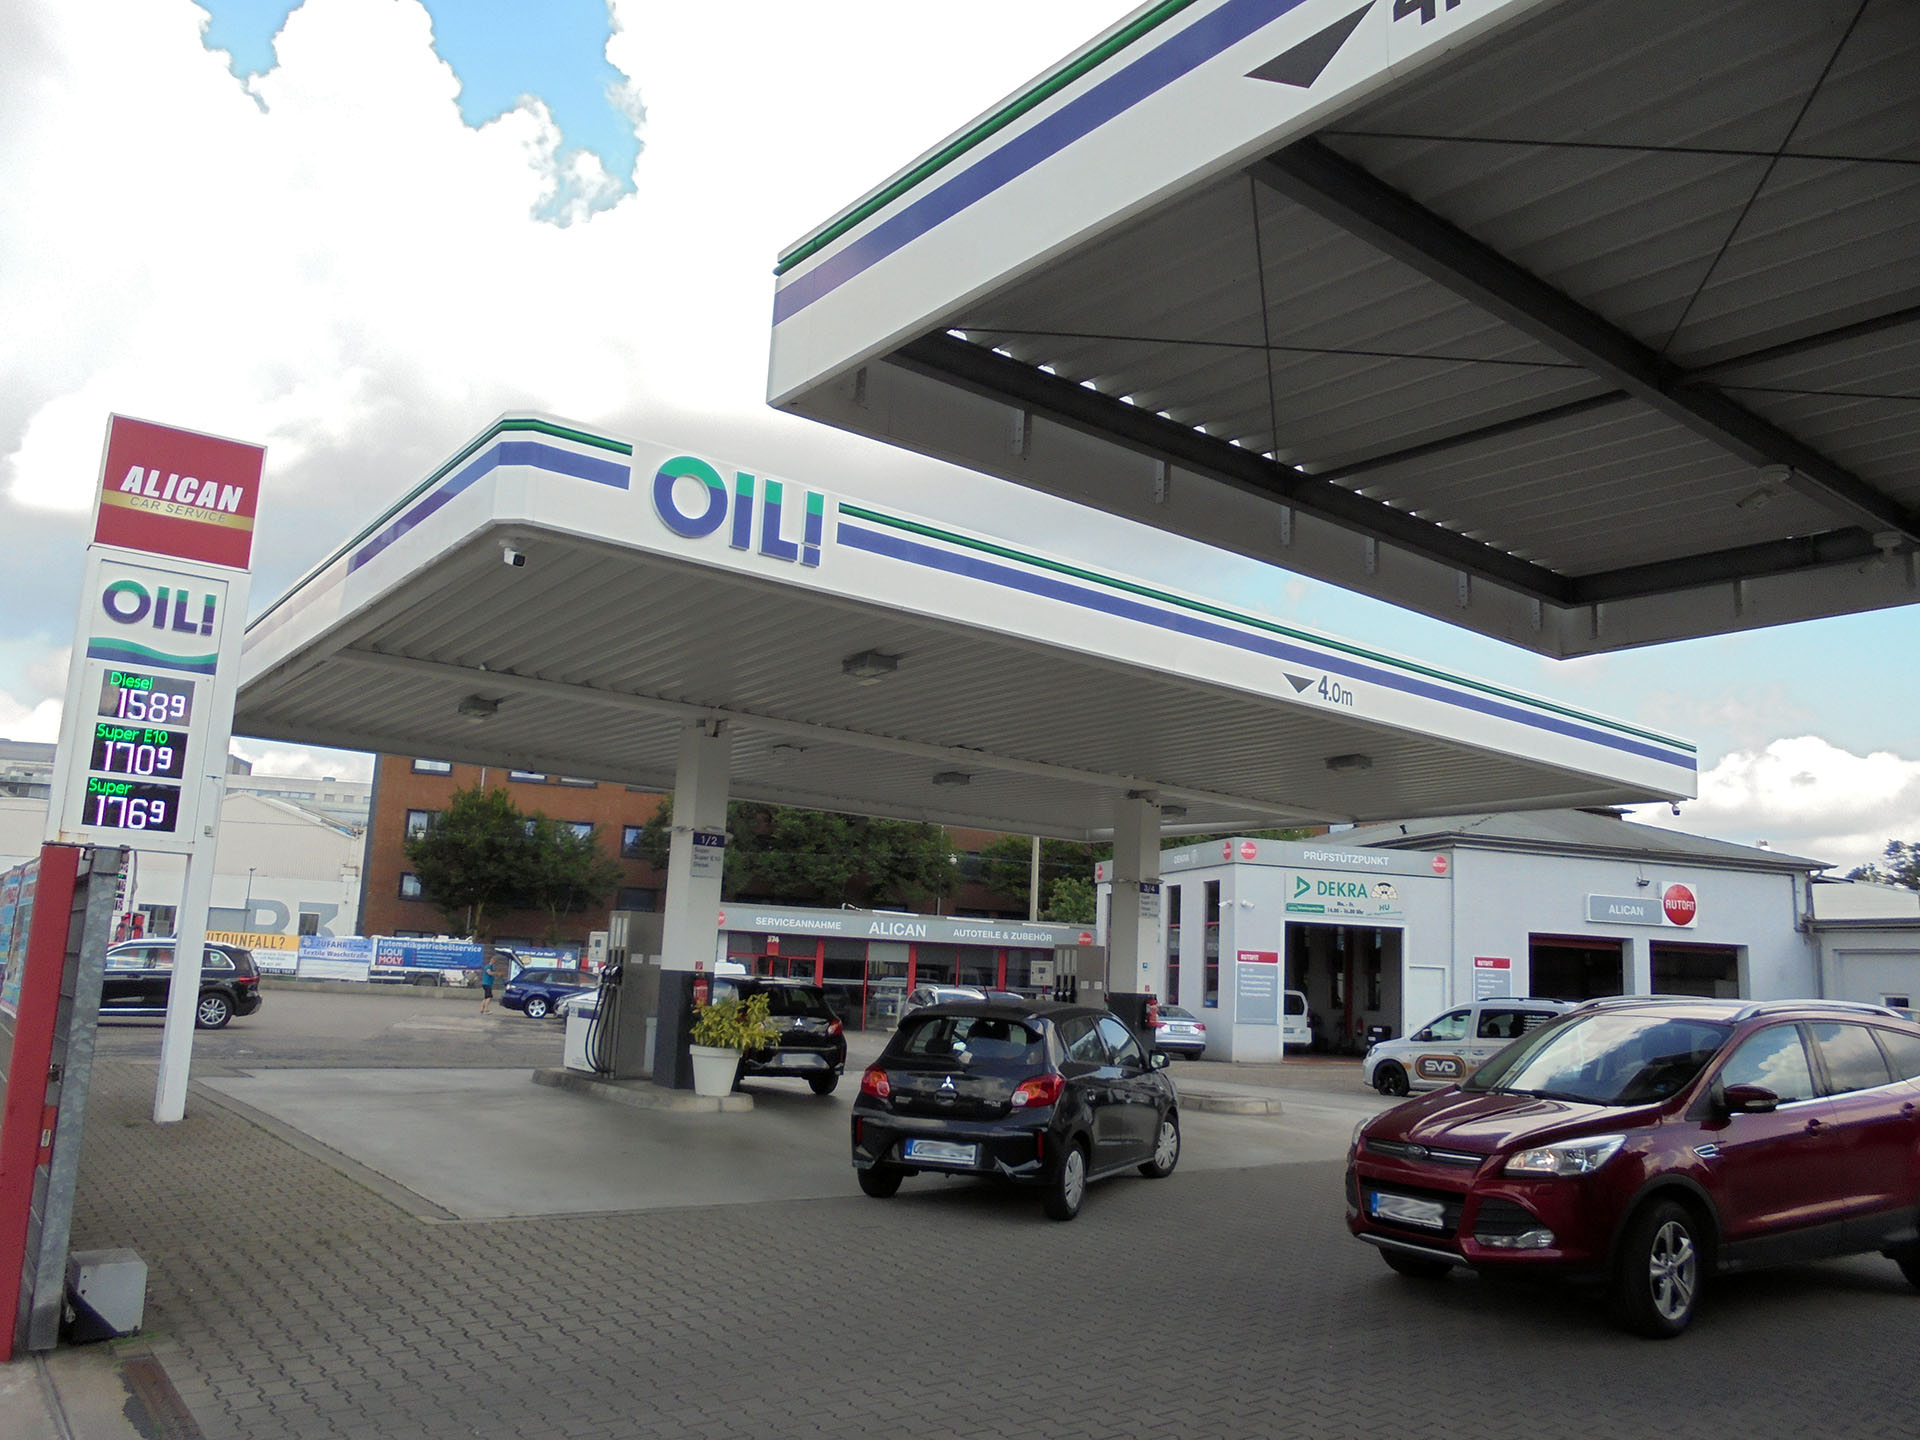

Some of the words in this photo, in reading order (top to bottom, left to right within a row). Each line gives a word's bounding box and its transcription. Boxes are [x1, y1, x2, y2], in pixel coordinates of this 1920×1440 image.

[120, 465, 244, 513] ALICAN
[130, 496, 161, 512] CAR
[165, 501, 226, 524] SERVICE
[651, 456, 825, 568] OIL!
[102, 580, 216, 637] OIL!
[110, 671, 153, 690] Diesel
[1318, 675, 1353, 707] 4.0m
[97, 723, 140, 742] Super
[144, 728, 168, 744] E10
[88, 778, 132, 796] Super
[701, 835, 718, 846] 1/2
[1303, 849, 1390, 866] PRÜFSTÜTZPUNKT
[1143, 884, 1155, 892] 3/4
[1317, 880, 1368, 898] DEKRA
[1608, 904, 1644, 916] ALICAN
[1665, 899, 1695, 911] AUTOFIT
[755, 917, 841, 930] SERVICEANNAHME
[868, 922, 926, 937] ALICAN
[953, 929, 1000, 939] AUTOTEILE
[1010, 932, 1053, 942] ZUBEHÖR
[206, 931, 286, 949] UTOUNFALL?
[303, 949, 326, 957] Textile
[327, 950, 369, 959] Waschstraße
[378, 956, 404, 965] MOLY
[379, 948, 403, 956] LIQUI
[1425, 1060, 1456, 1072] SVD
